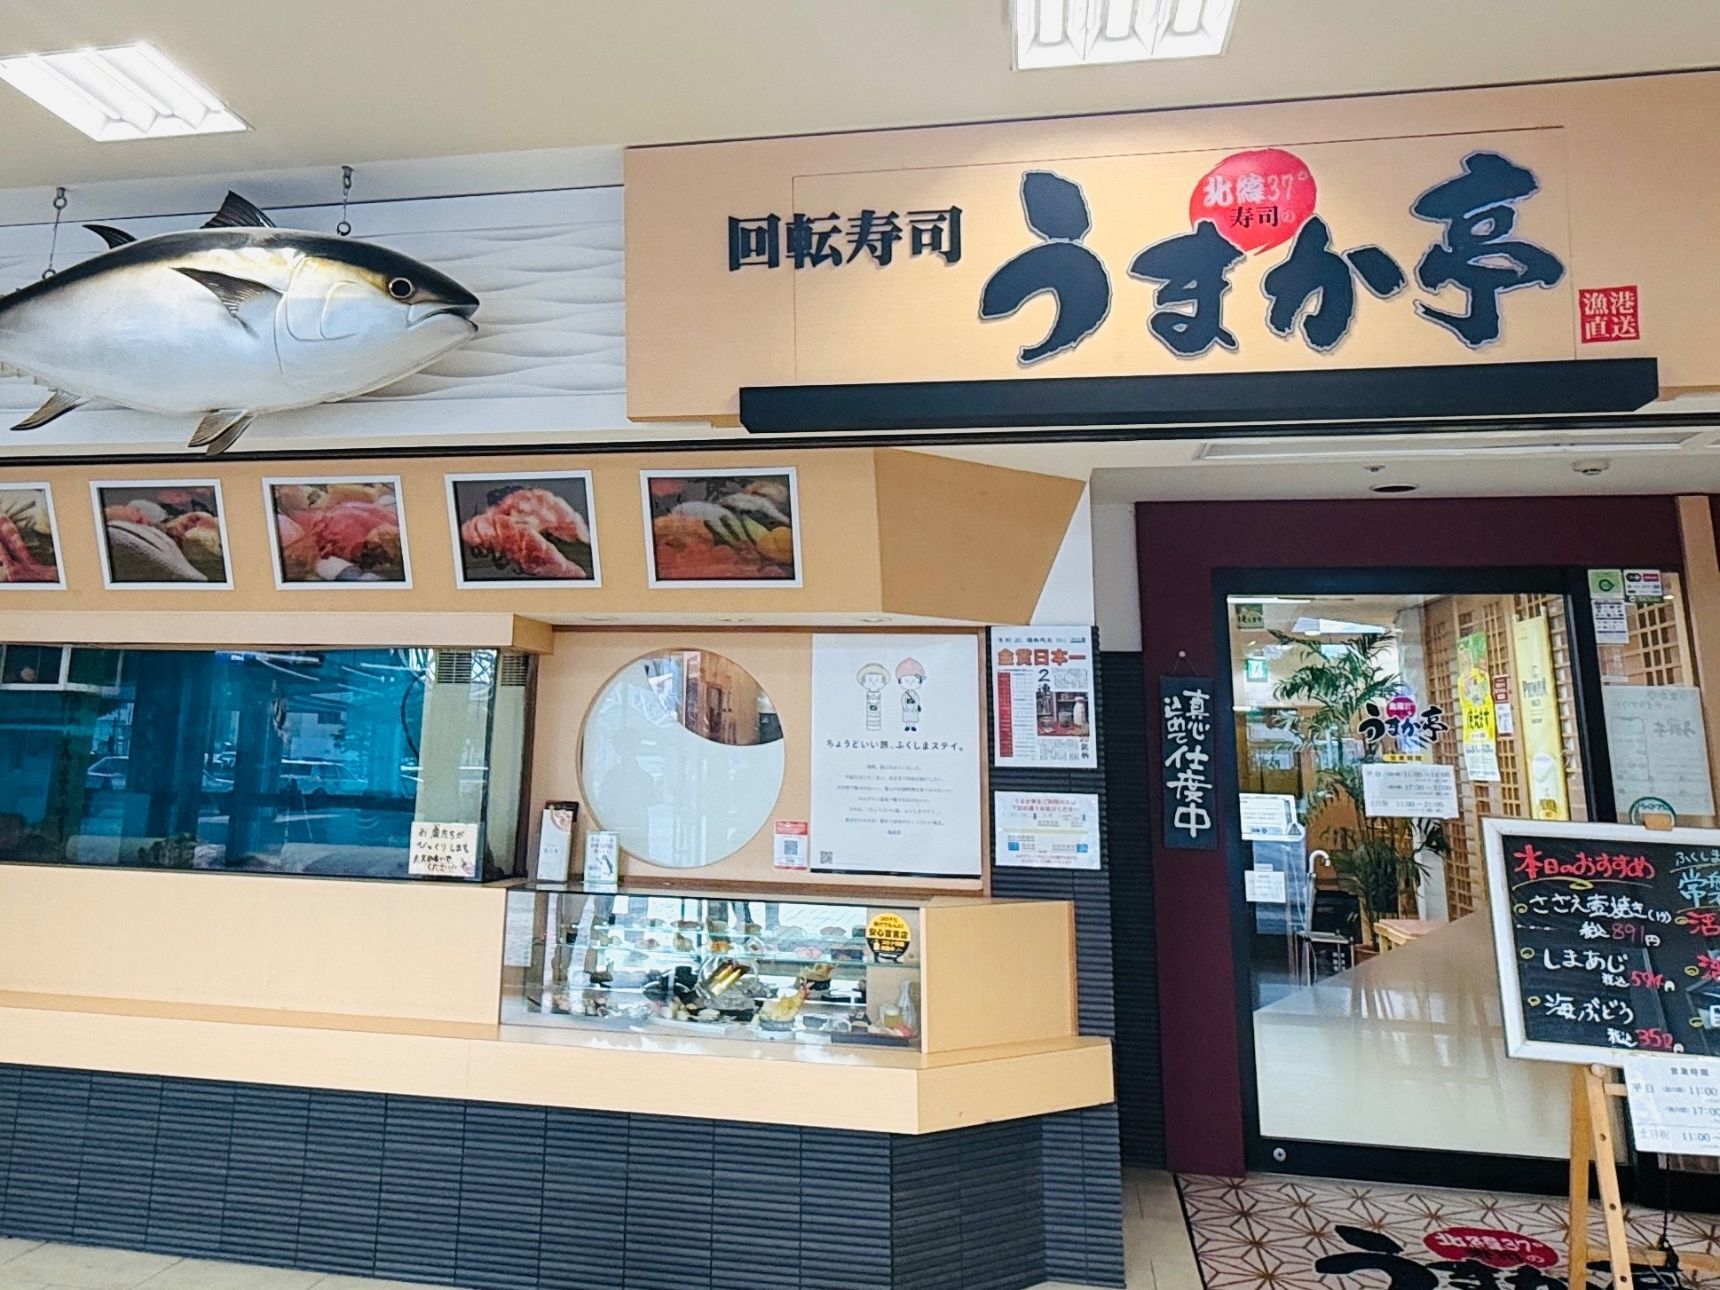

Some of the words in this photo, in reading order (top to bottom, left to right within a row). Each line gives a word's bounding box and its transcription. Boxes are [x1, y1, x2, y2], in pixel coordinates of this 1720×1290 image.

[1230, 204, 1296, 228] 寿司の
[727, 205, 963, 271] 回転寿司
[978, 150, 1567, 368] うまか亭
[1584, 289, 1636, 315] 漁港
[1585, 315, 1637, 341] 直送
[996, 648, 1087, 666] 金賞日本一
[1358, 702, 1449, 743] うまか亭
[826, 738, 964, 751] ちょうどいい旅、ふくしまステイ。
[1514, 844, 1656, 880] 本日のおすすめ
[1675, 849, 1720, 867] ふくしま
[1543, 948, 1628, 974] しまあじ
[1544, 992, 1634, 1025] 海ぶどう
[1670, 1067, 1710, 1077] 営業時間
[1632, 1083, 1655, 1093] 平日
